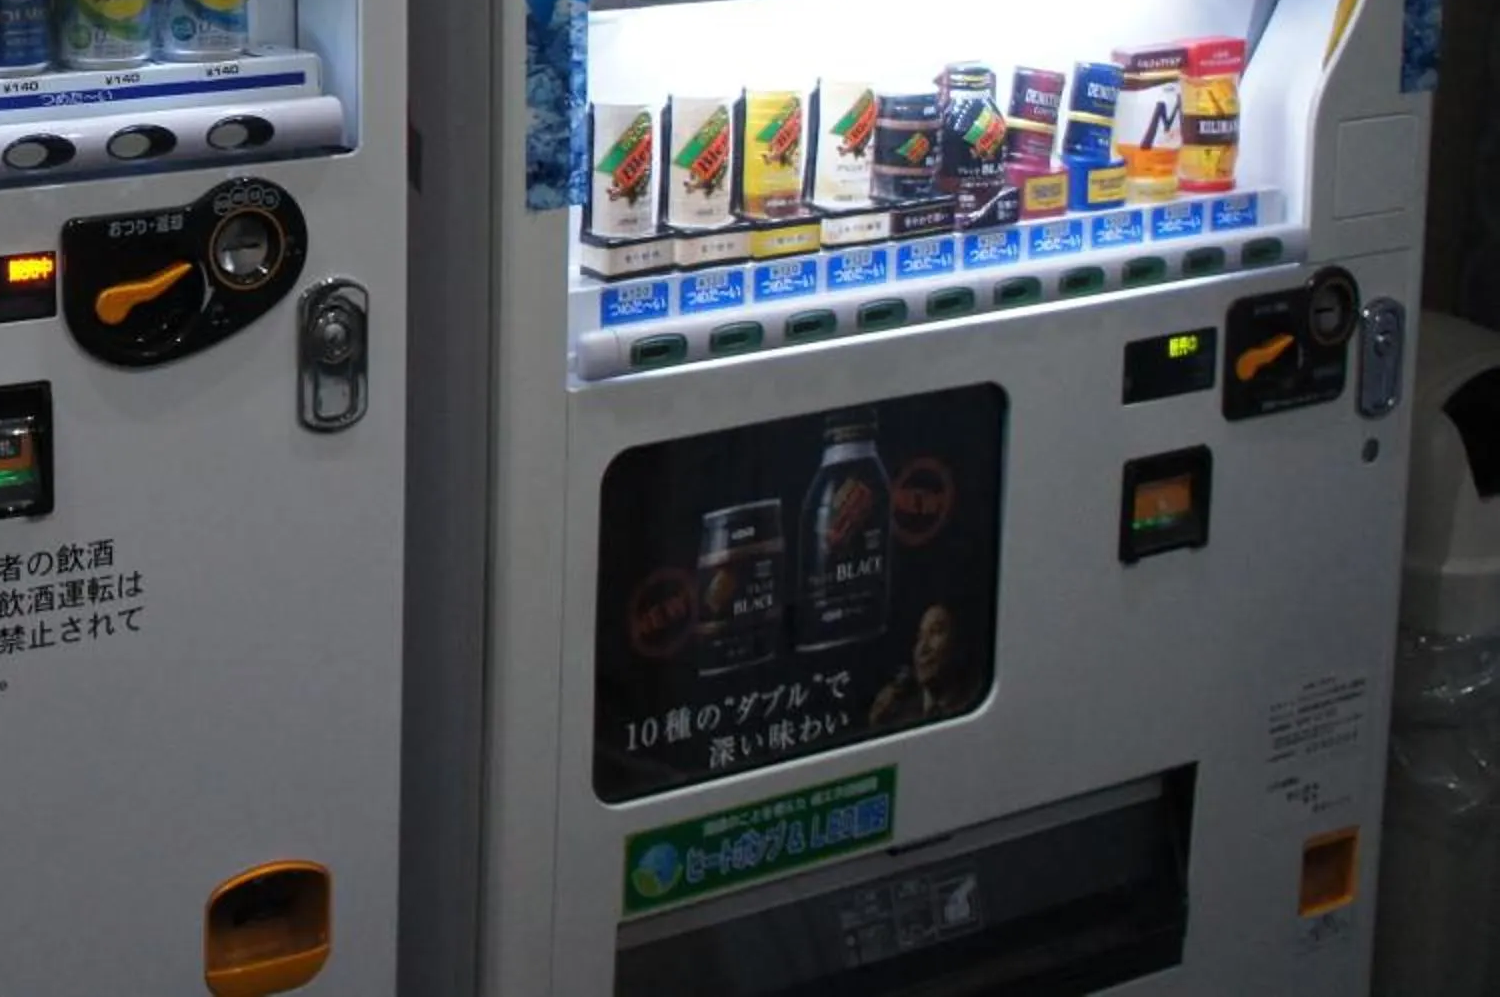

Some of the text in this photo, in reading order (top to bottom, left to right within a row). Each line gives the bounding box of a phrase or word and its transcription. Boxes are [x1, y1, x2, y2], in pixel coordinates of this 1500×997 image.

[708, 713, 850, 769] 深い味わい
